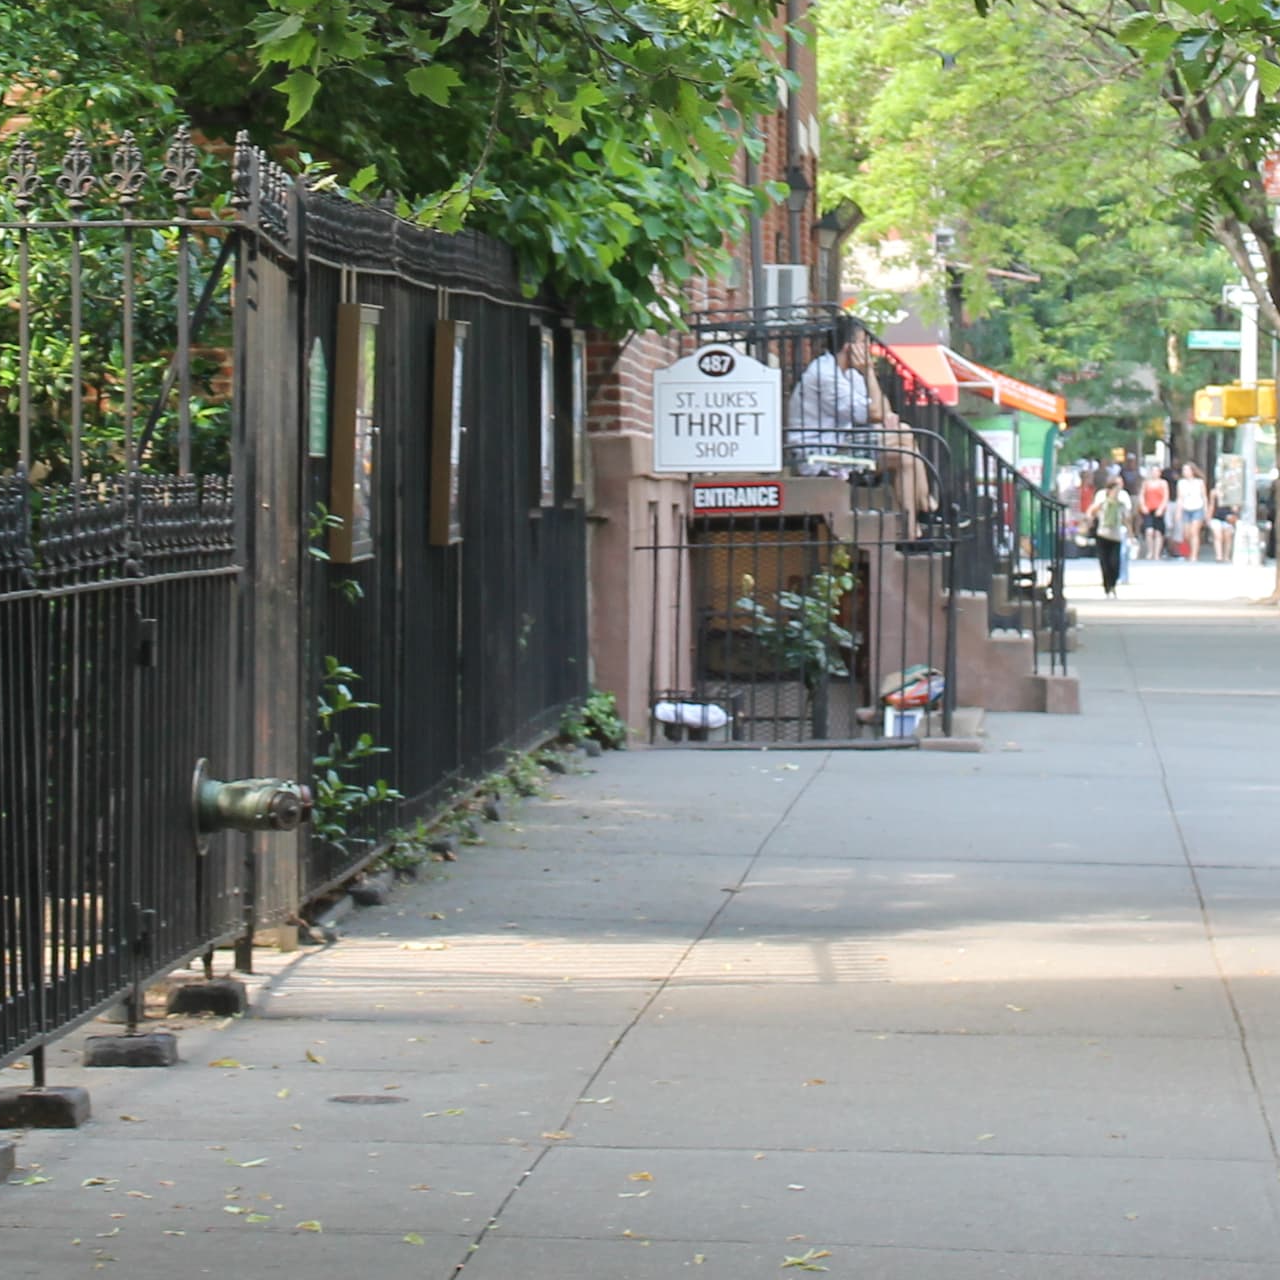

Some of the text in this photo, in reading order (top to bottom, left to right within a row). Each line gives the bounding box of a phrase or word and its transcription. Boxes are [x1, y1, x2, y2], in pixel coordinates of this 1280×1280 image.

[700, 354, 731, 372] 487
[676, 391, 758, 408] ST. LUKE'S
[669, 412, 766, 437] THRIFT
[695, 441, 740, 458] SHOP
[694, 486, 779, 508] ENTRANCE
